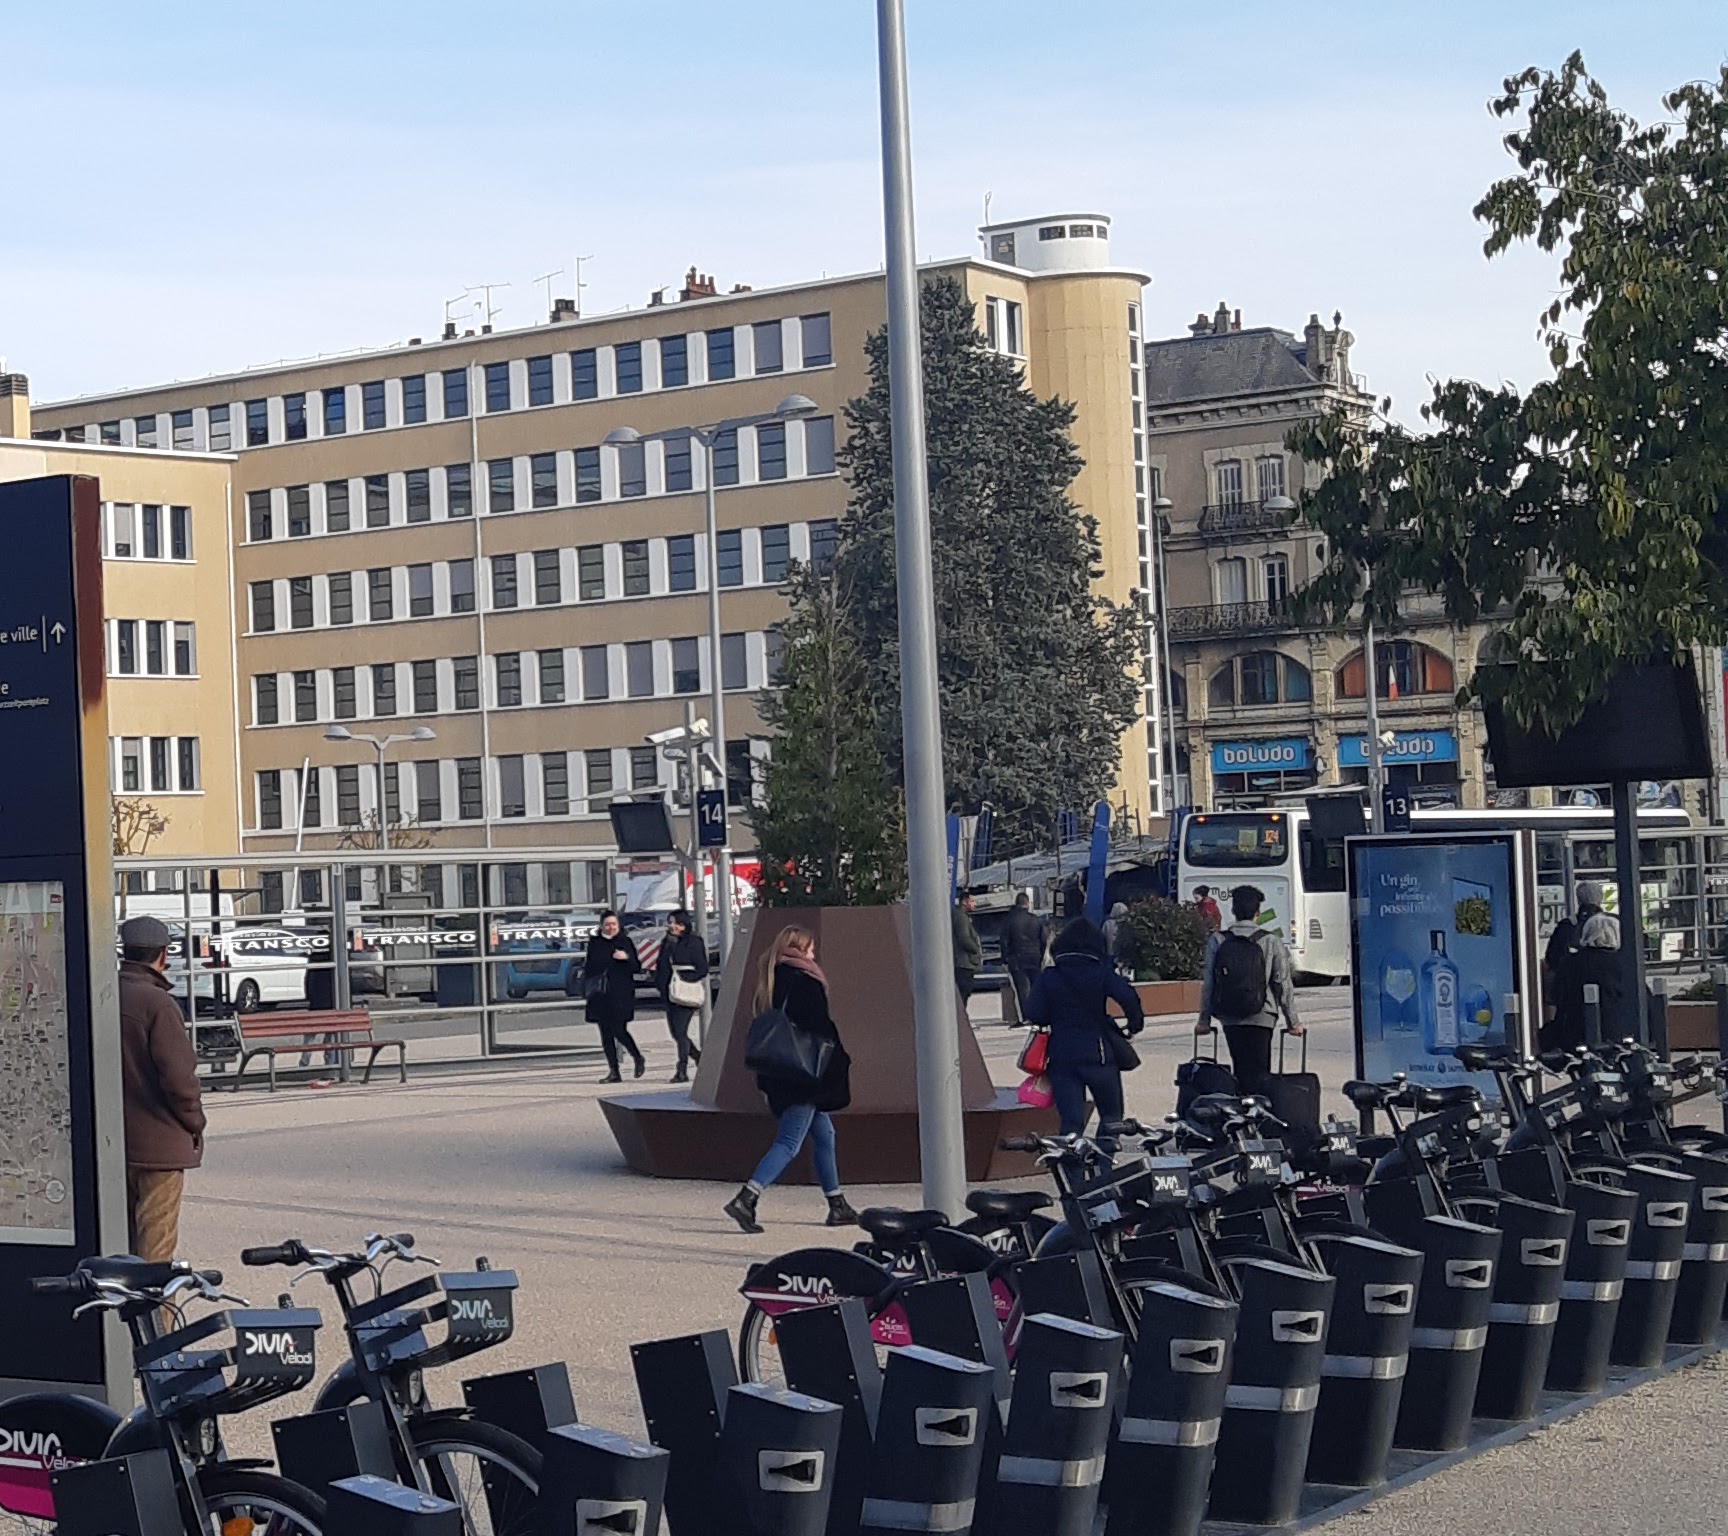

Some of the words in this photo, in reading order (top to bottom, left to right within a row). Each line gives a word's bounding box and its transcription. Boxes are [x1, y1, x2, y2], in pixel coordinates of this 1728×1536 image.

[11, 626, 38, 642] ville
[1360, 737, 1435, 757] bludo
[700, 803, 723, 824] 14
[1386, 798, 1407, 815] 13
[209, 937, 330, 952] TRANSCO
[364, 933, 476, 946] TRANSCO
[777, 1272, 834, 1295] DIVIA
[451, 1299, 493, 1320] DIVIA
[245, 1331, 297, 1355] DIVIA
